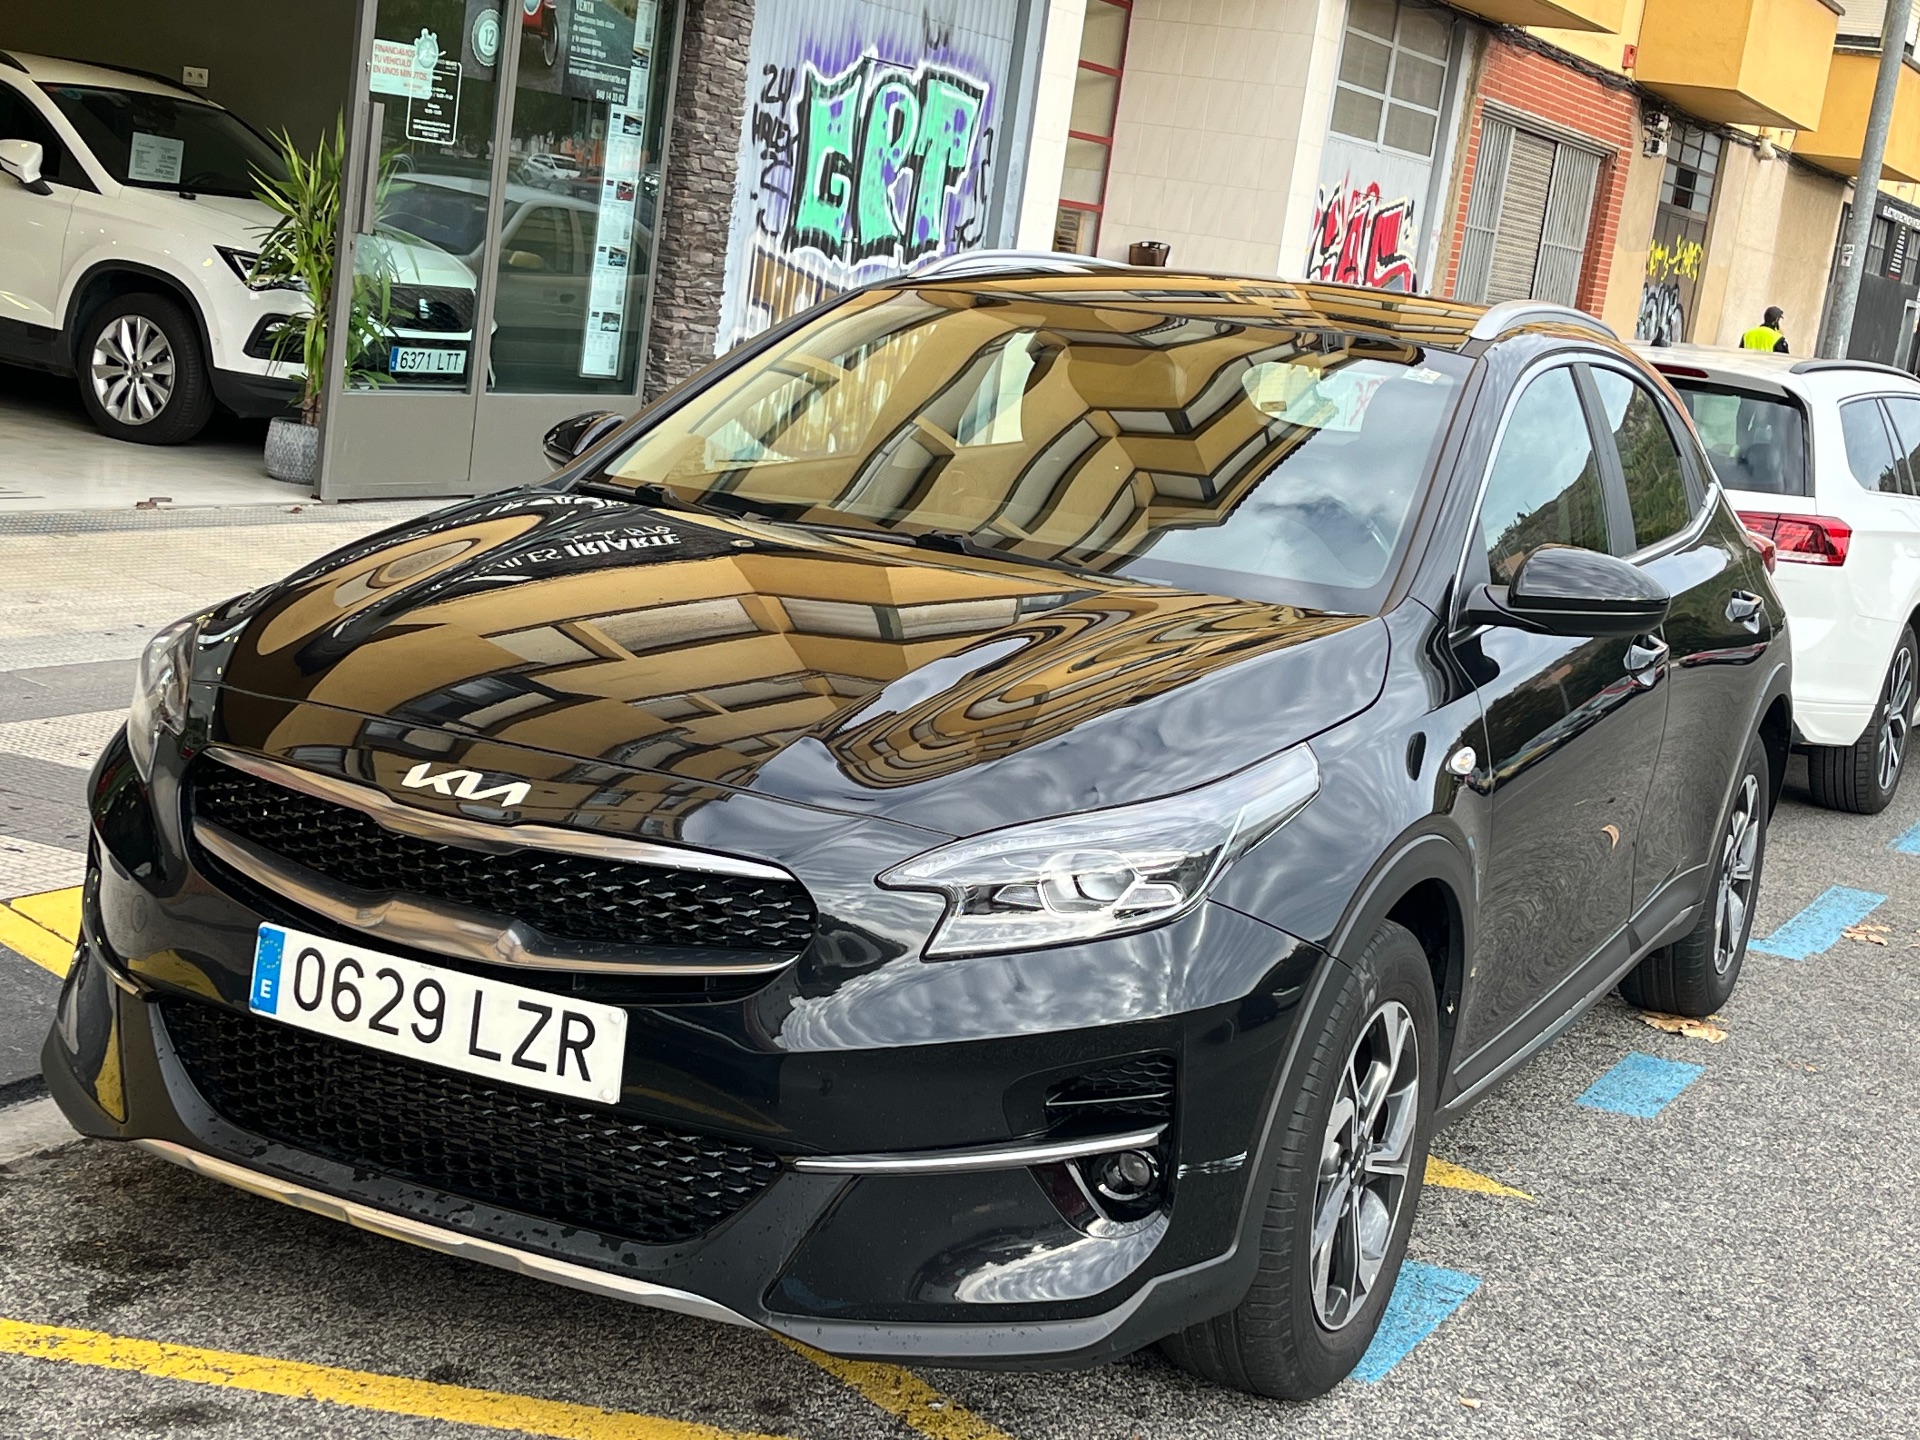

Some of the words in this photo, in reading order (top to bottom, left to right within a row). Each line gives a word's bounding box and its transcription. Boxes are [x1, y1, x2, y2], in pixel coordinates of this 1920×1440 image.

[484, 28, 495, 47] 12
[400, 350, 432, 370] 6371
[437, 352, 461, 371] LTT
[260, 978, 273, 999] E
[293, 946, 446, 1044] 0629
[468, 988, 597, 1083] LZR
